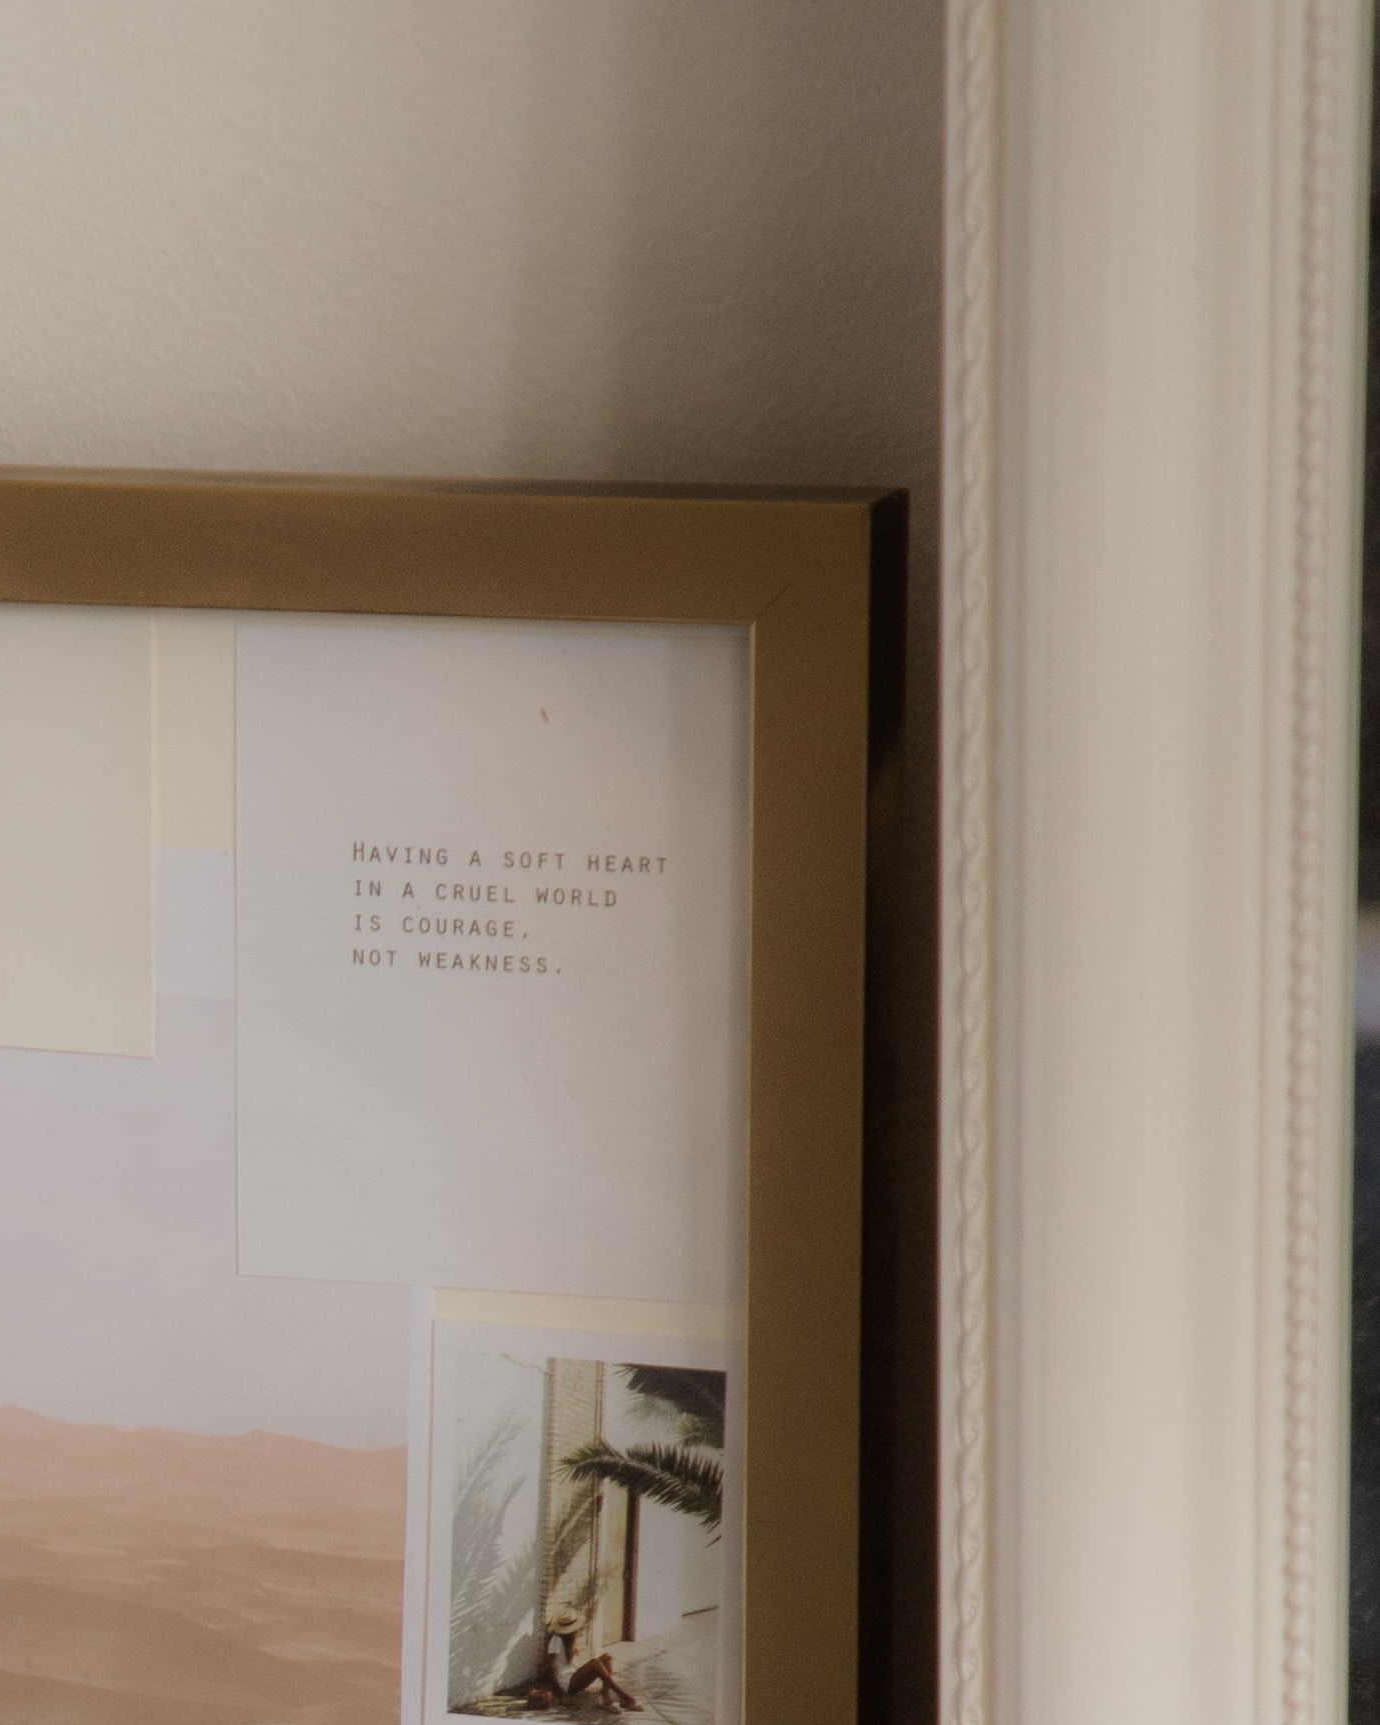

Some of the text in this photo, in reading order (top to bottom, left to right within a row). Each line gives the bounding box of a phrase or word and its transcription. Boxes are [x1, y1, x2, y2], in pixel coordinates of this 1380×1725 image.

[352, 842, 668, 875] HAVING A SOFT HEART
[355, 879, 618, 908] IN A CRUEL WORLD
[355, 914, 530, 940] IS COURAGE,
[352, 949, 563, 975] NOT WEAKNESS.
